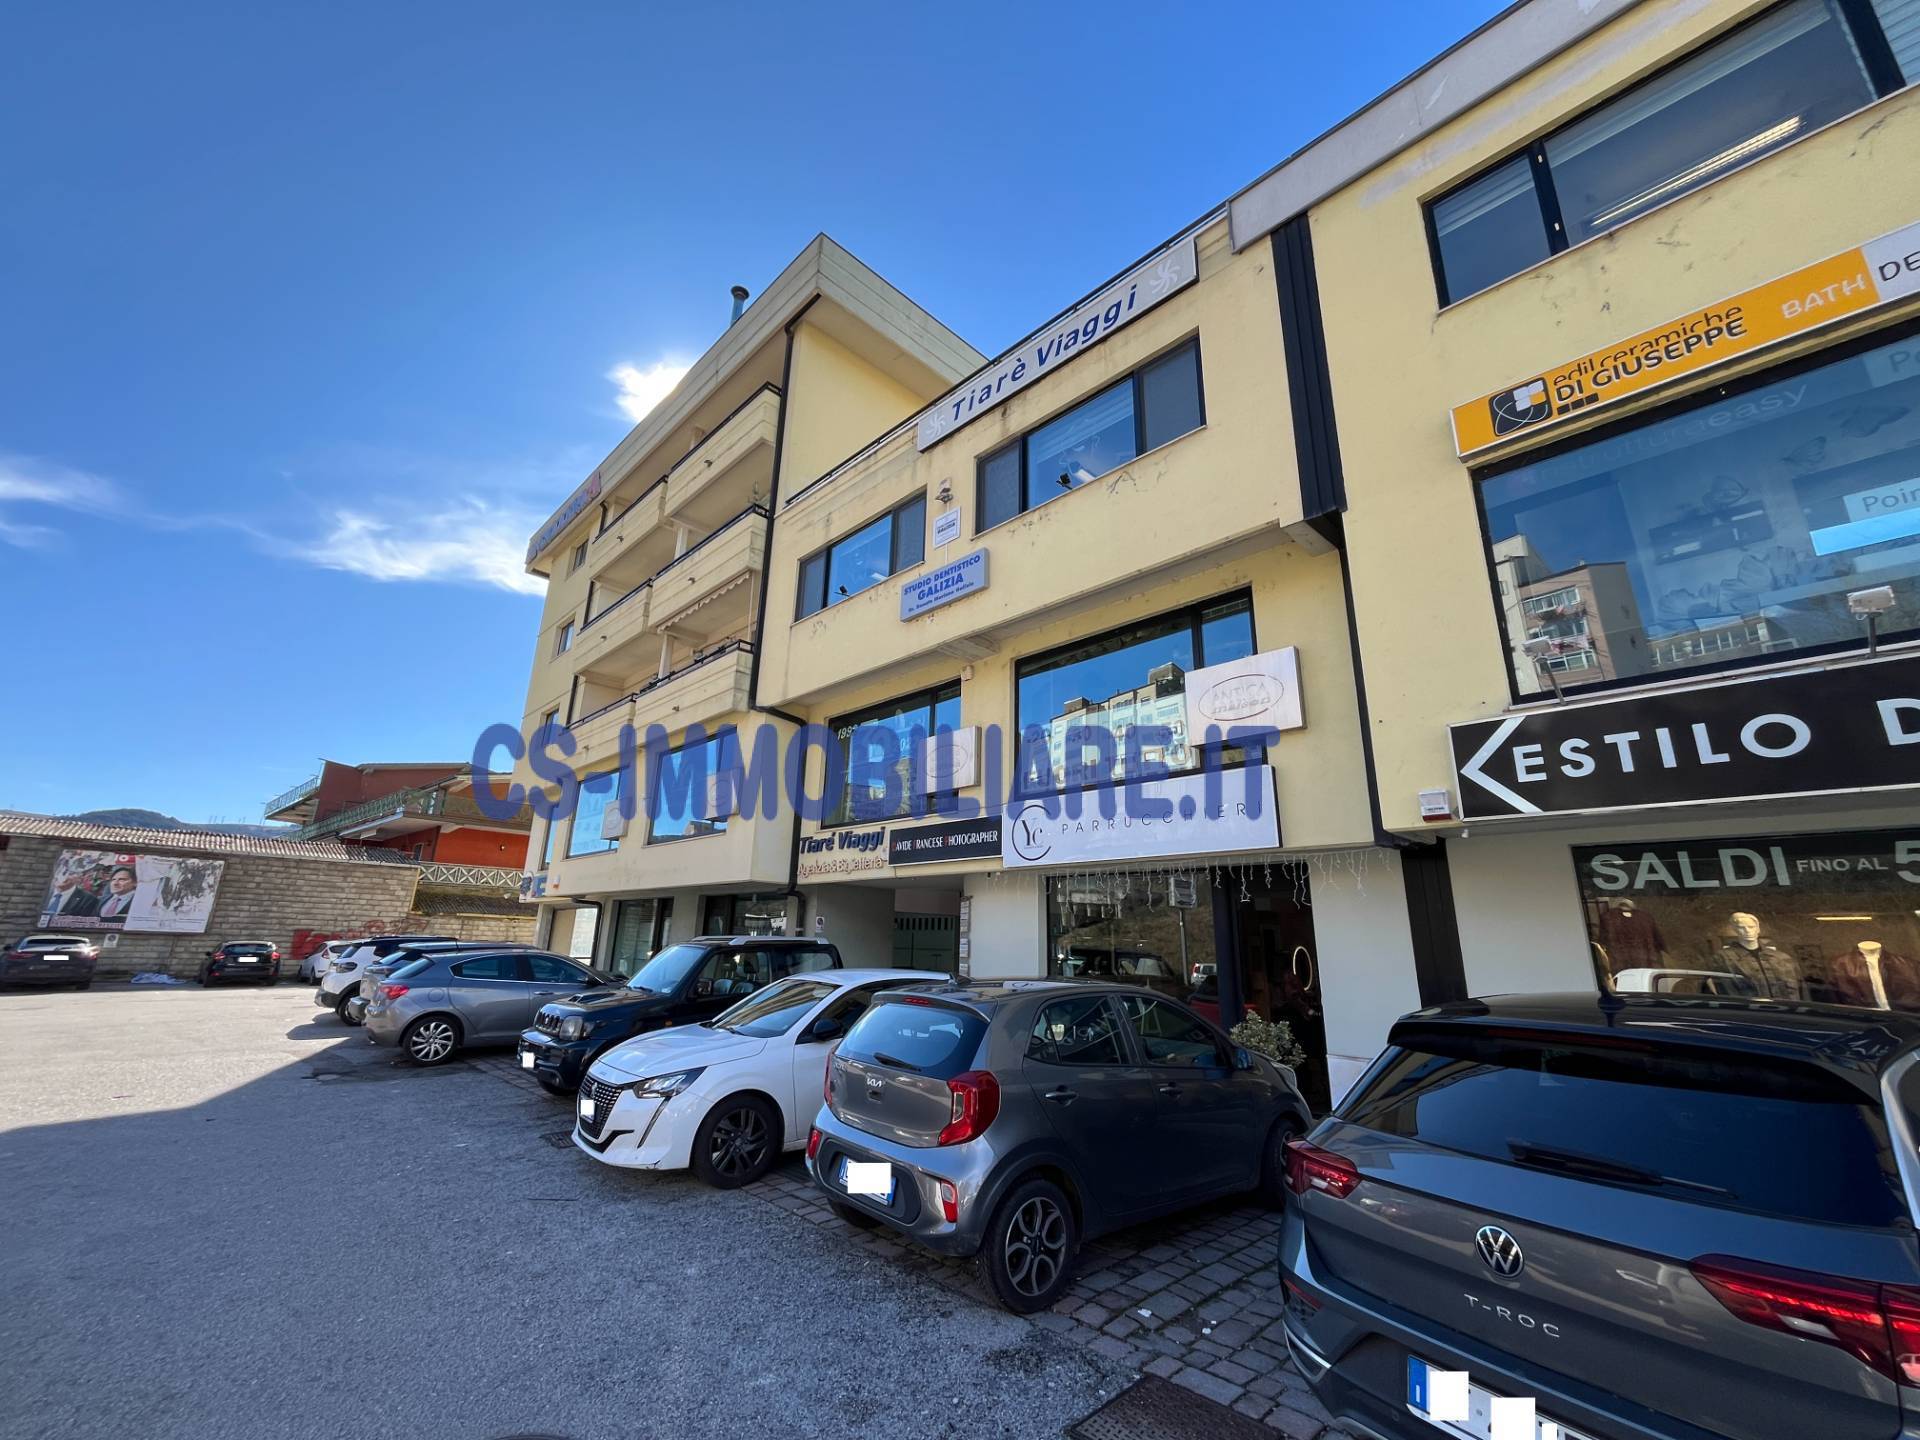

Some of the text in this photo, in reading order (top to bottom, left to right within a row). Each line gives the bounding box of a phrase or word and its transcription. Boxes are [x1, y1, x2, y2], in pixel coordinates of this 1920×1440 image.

[1781, 273, 1866, 319] BATH
[951, 283, 1138, 421] Tiarè Viaggi
[1553, 305, 1743, 386] edil ceramiche
[1556, 317, 1748, 402] DI GIUSEPPE
[904, 554, 981, 596] STUDIO DENTISTICO
[917, 572, 964, 601] GALIZIA
[1511, 713, 1812, 784] ESTILO
[800, 825, 886, 854] Tiaré Viaggi
[944, 830, 998, 847] PHOTOGRAPHER
[1061, 802, 1263, 835] PARRUCCHIERI
[1590, 844, 1791, 891] SALDI
[1796, 857, 1851, 873] FINO
[1857, 856, 1889, 871] AL
[1463, 1292, 1561, 1338] T-ROC
